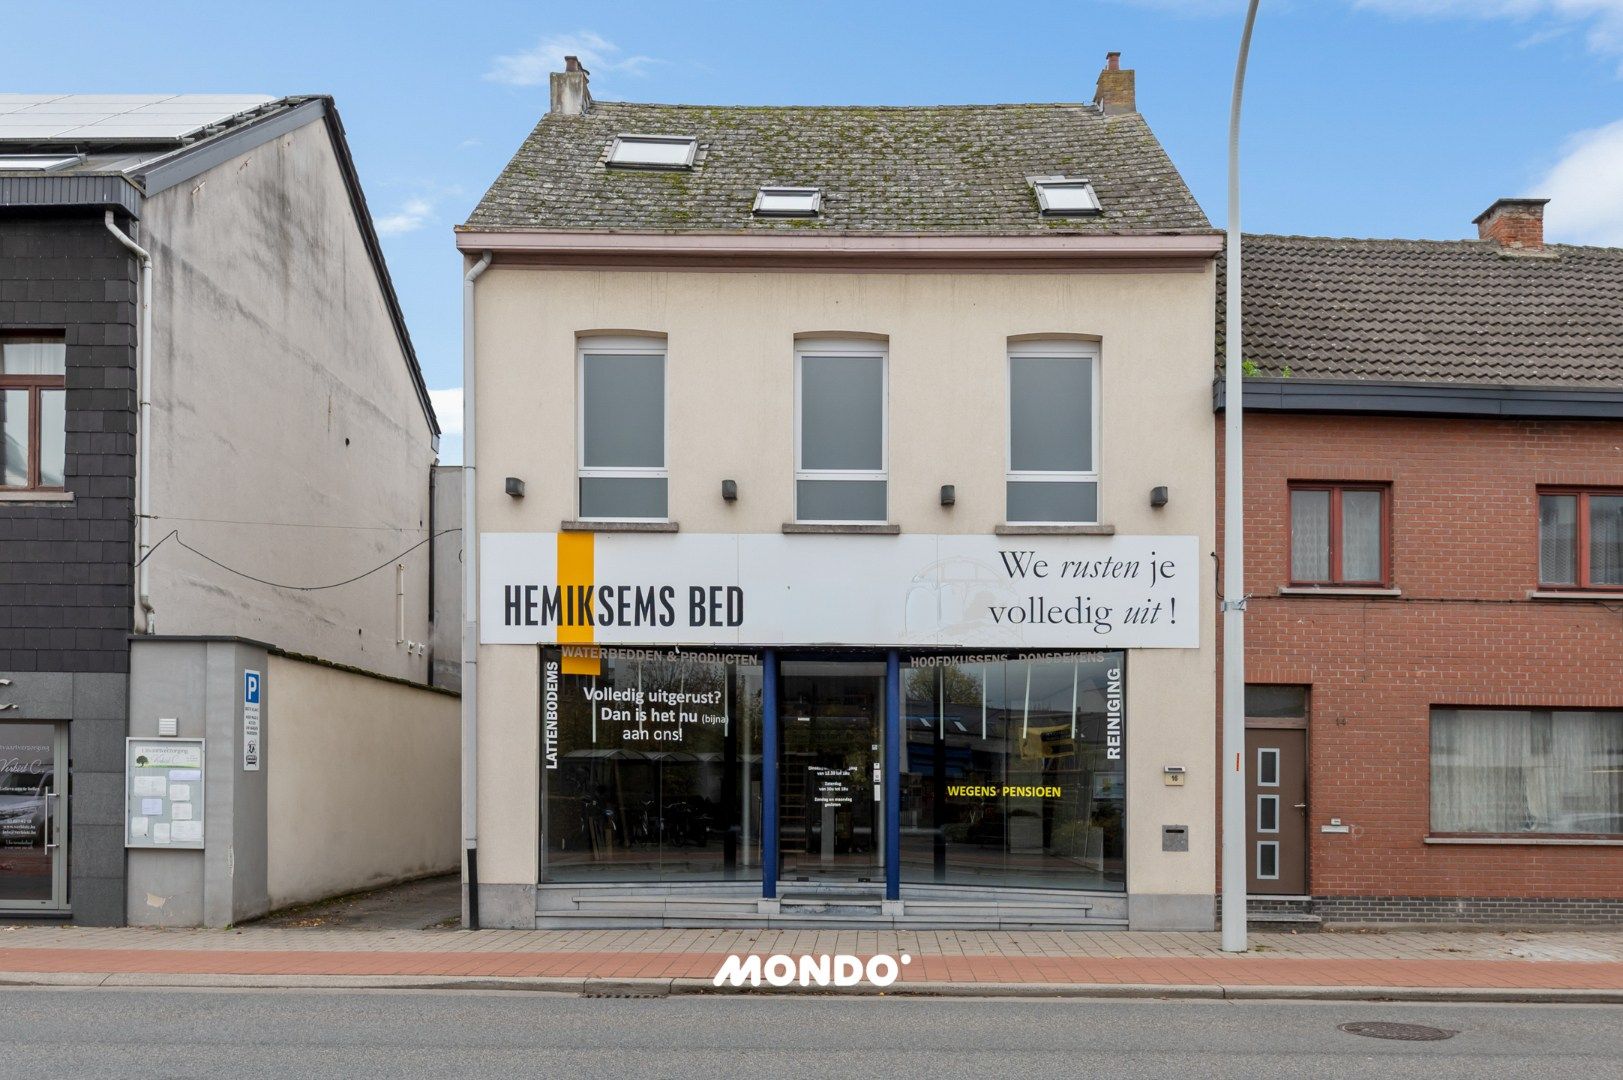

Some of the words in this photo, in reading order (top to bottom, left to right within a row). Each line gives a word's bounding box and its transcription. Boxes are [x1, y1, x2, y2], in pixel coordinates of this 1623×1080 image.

[999, 551, 1048, 578] We
[1061, 556, 1140, 578] rusten
[1150, 551, 1176, 588] je
[504, 584, 675, 627] HEMIKSEMS
[689, 585, 744, 627] BED
[988, 596, 1113, 635] volledig
[1123, 598, 1162, 624] uit
[561, 645, 662, 663] WATERBEDDEN
[666, 651, 678, 663] &
[680, 651, 758, 667] PRODUCTEN
[910, 653, 1009, 668] HOOFDKUSSENS
[1018, 650, 1105, 664] DONSDEKENS
[582, 686, 645, 705] Volledig
[648, 689, 722, 706] uitgerust?
[545, 661, 559, 770] LATTENBODEMS
[600, 707, 631, 722] Dan
[635, 708, 647, 722] is
[651, 708, 676, 723] het
[680, 710, 698, 723] nu
[701, 714, 729, 725] (bijna)
[1106, 667, 1121, 760] REINIGING
[622, 727, 649, 740] aan
[653, 727, 683, 742] ons!
[947, 785, 997, 797] WEGENS
[1002, 786, 1062, 798] PENSIOEN
